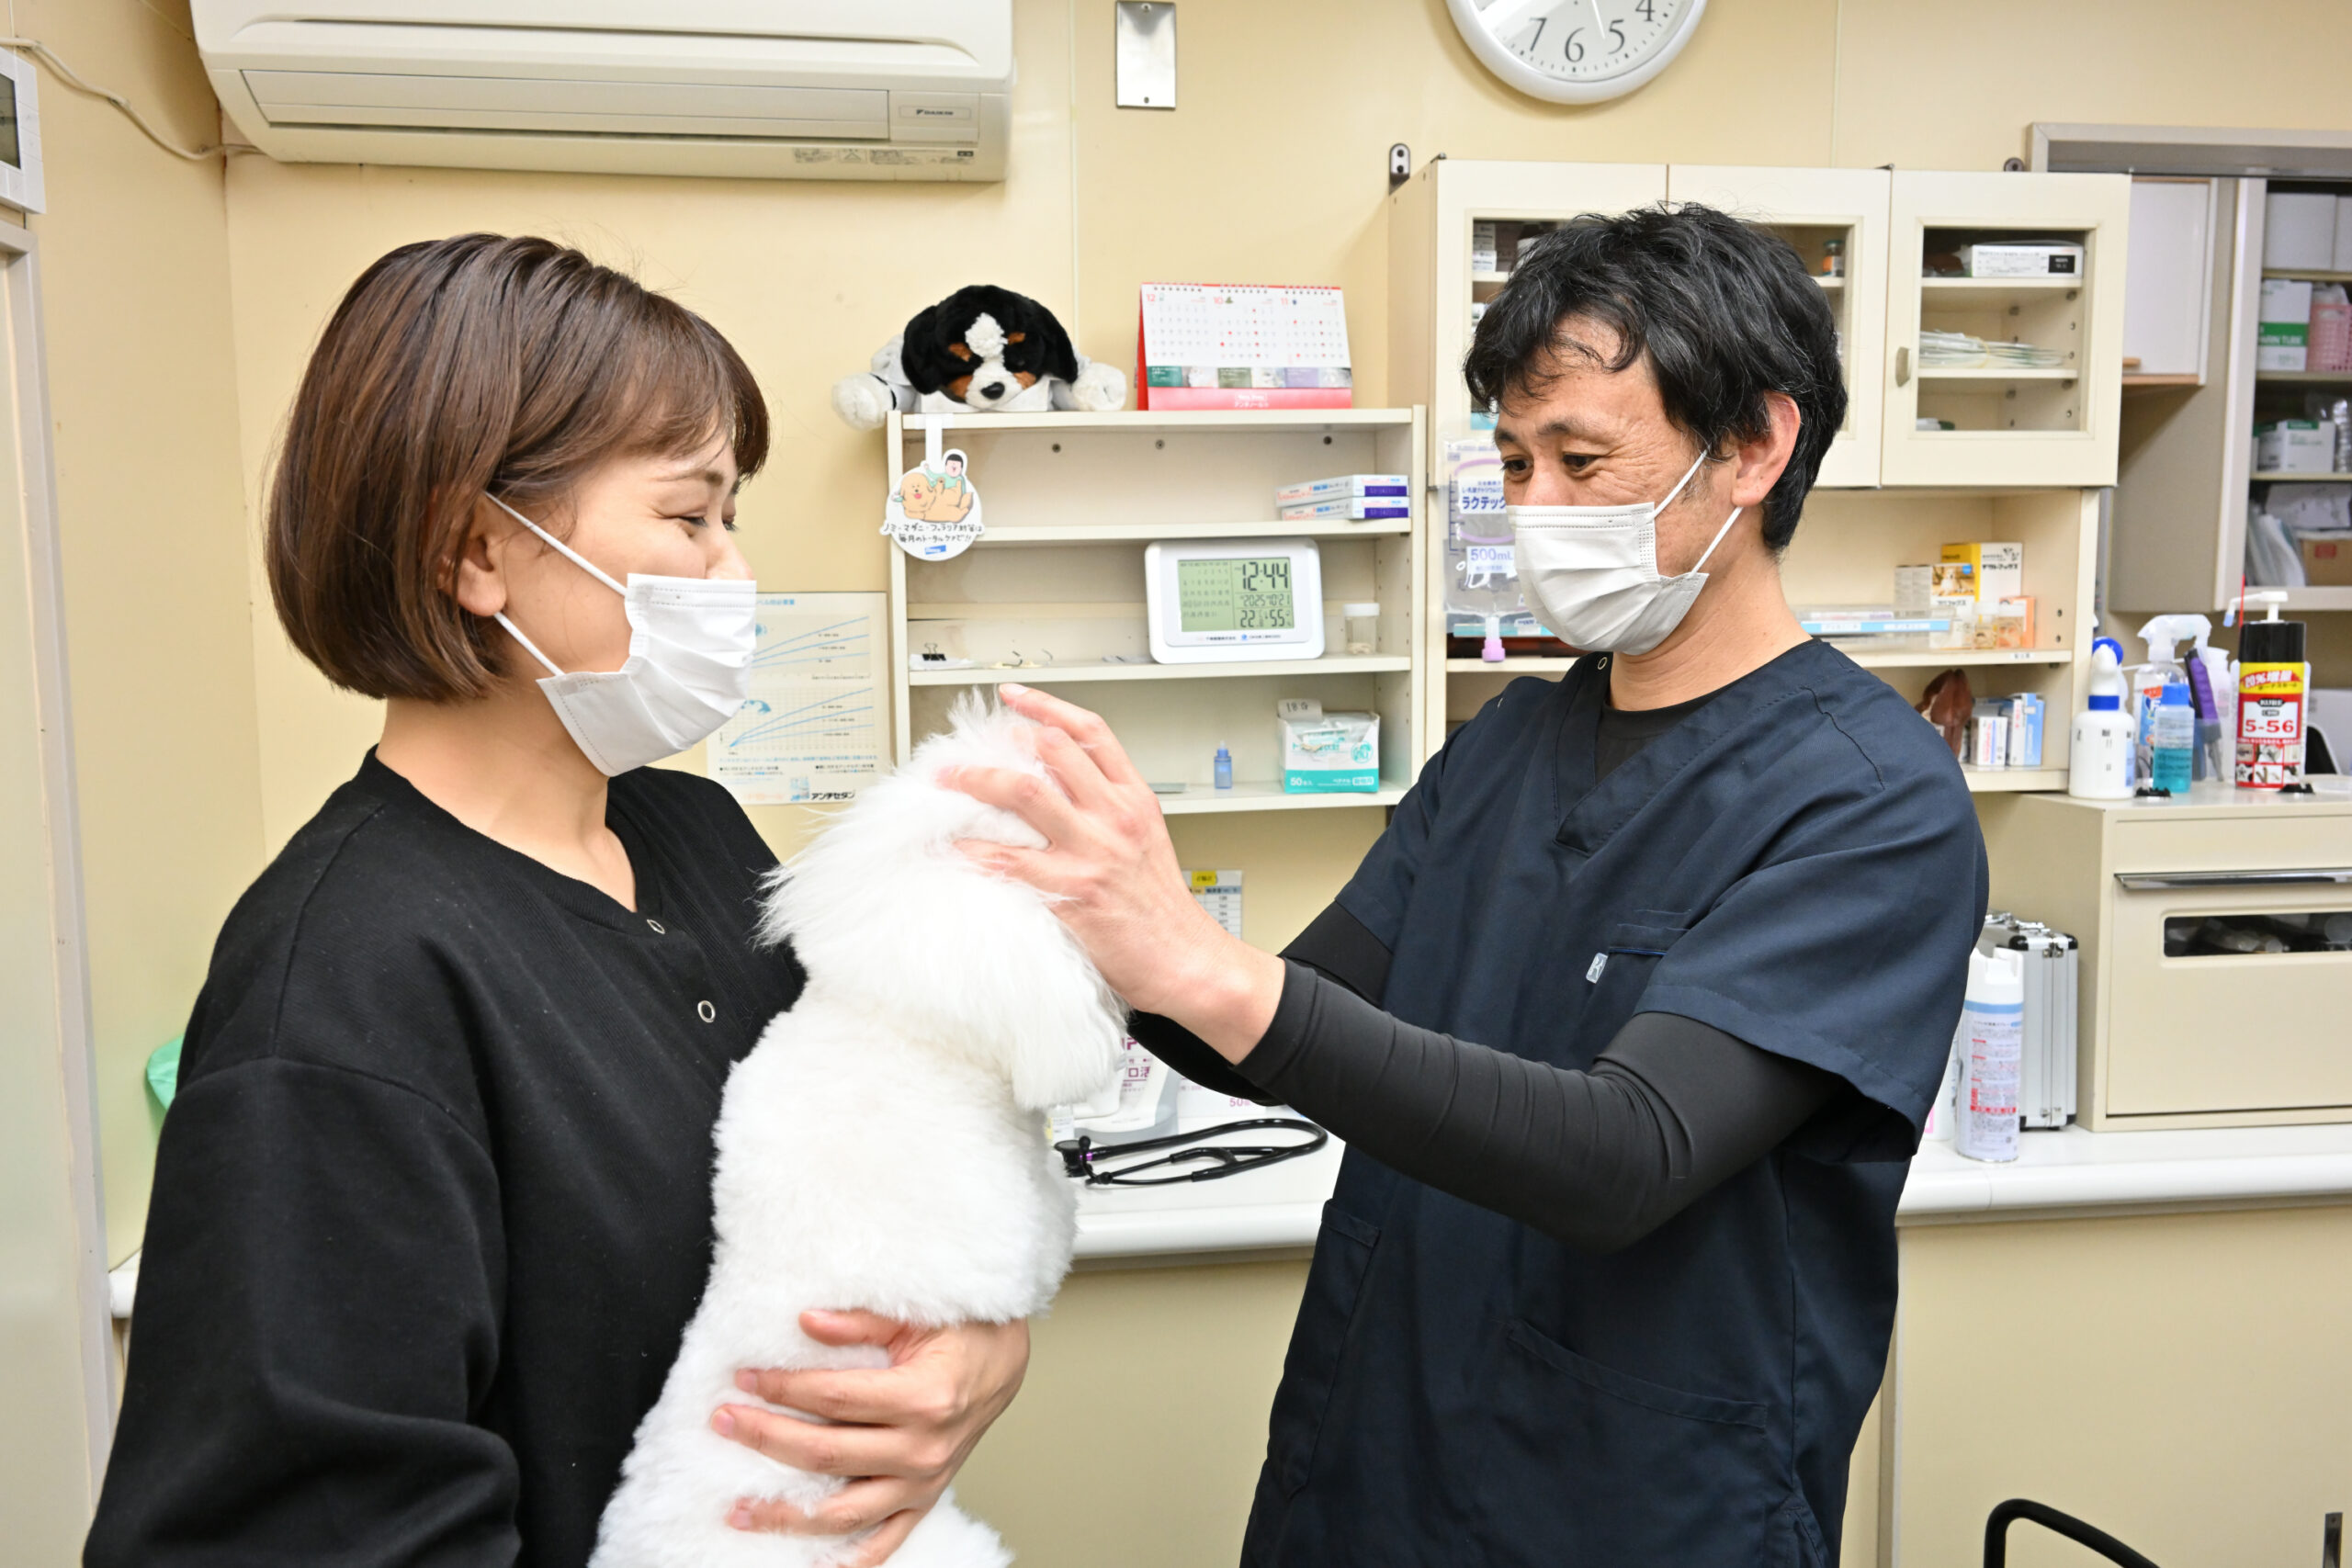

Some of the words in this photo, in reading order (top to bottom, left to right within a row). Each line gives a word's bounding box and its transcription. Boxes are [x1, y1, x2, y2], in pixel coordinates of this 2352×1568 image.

[1634, 0, 1656, 22] 4
[1529, 17, 1548, 52] 7
[1564, 27, 1586, 62] 6
[1607, 19, 1625, 55] 5
[1470, 547, 1514, 561] 500mL
[1242, 561, 1289, 592] 12:44
[1240, 609, 1256, 627] 22
[1270, 609, 1285, 626] 55
[2245, 719, 2295, 733] 5-56
[810, 789, 855, 800] アンチセダン
